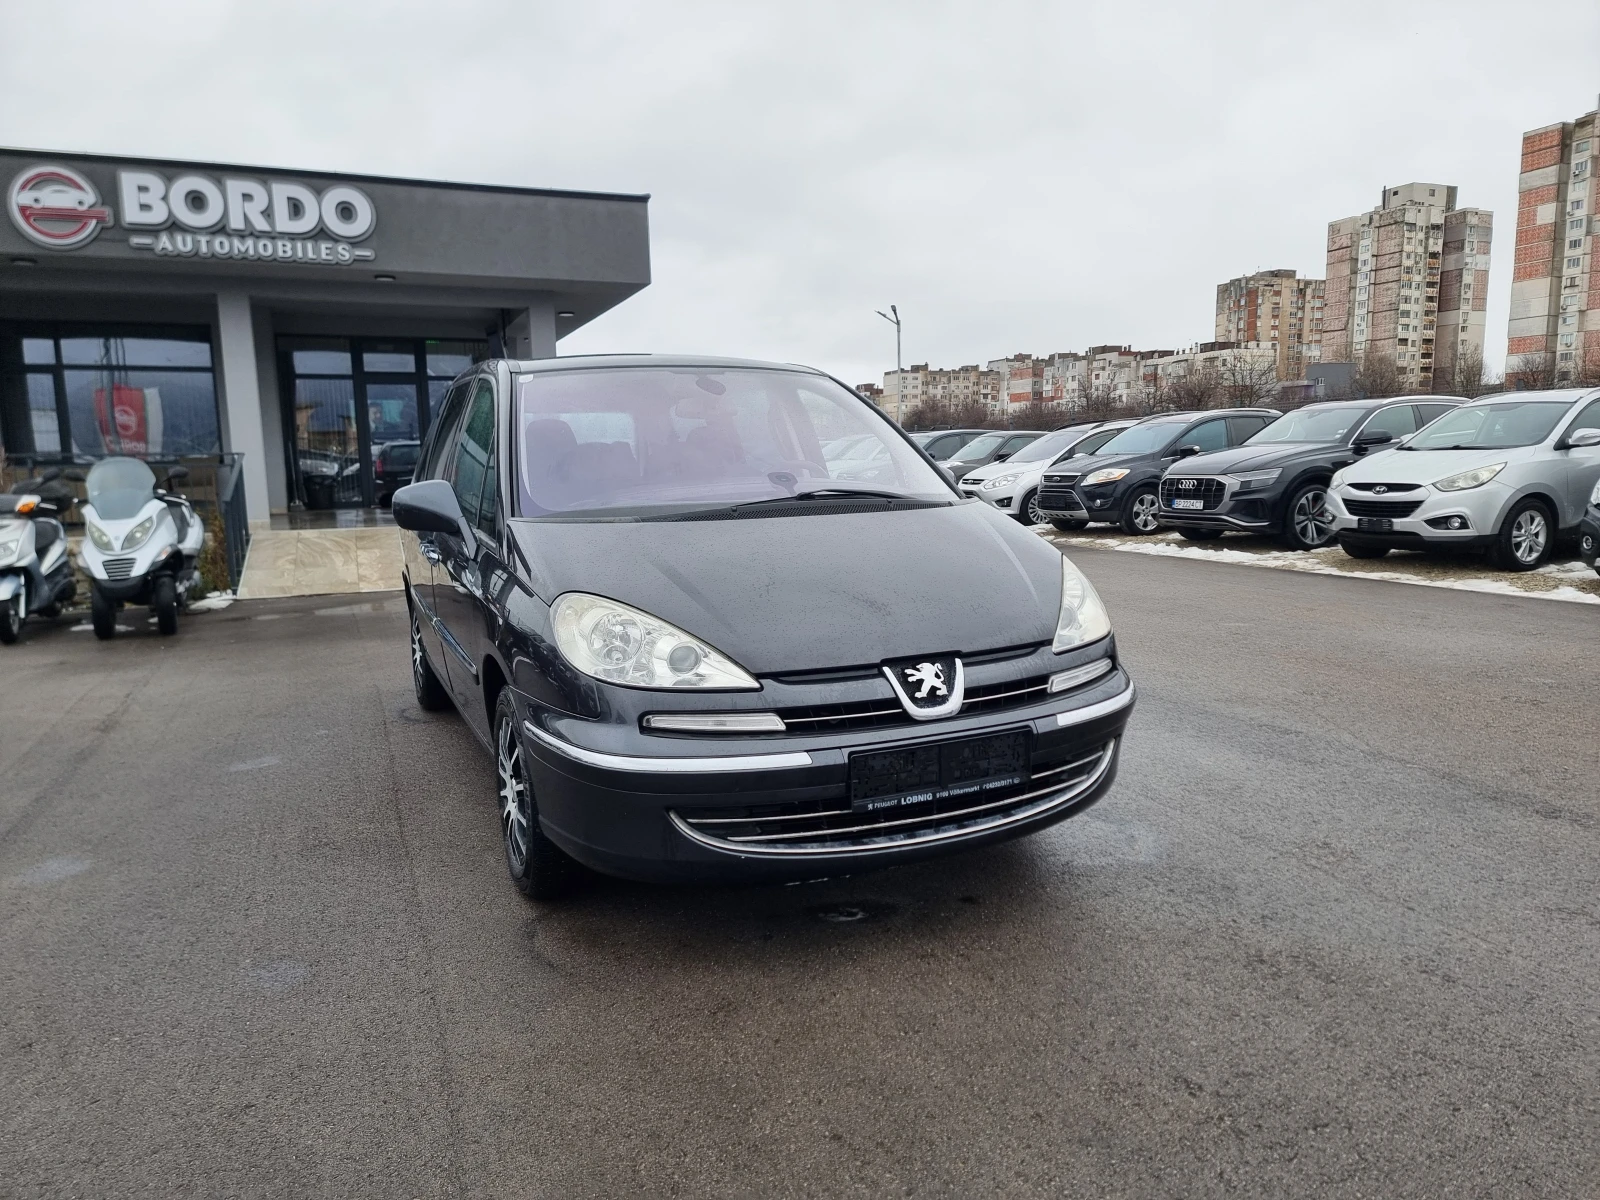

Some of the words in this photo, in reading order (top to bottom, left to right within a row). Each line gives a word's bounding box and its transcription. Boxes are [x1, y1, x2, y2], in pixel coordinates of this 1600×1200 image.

[120, 171, 372, 237] BORDO
[157, 235, 351, 262] AUTOMOBILES
[874, 800, 898, 809] PEUGEOT
[901, 793, 933, 805] LOBNIG
